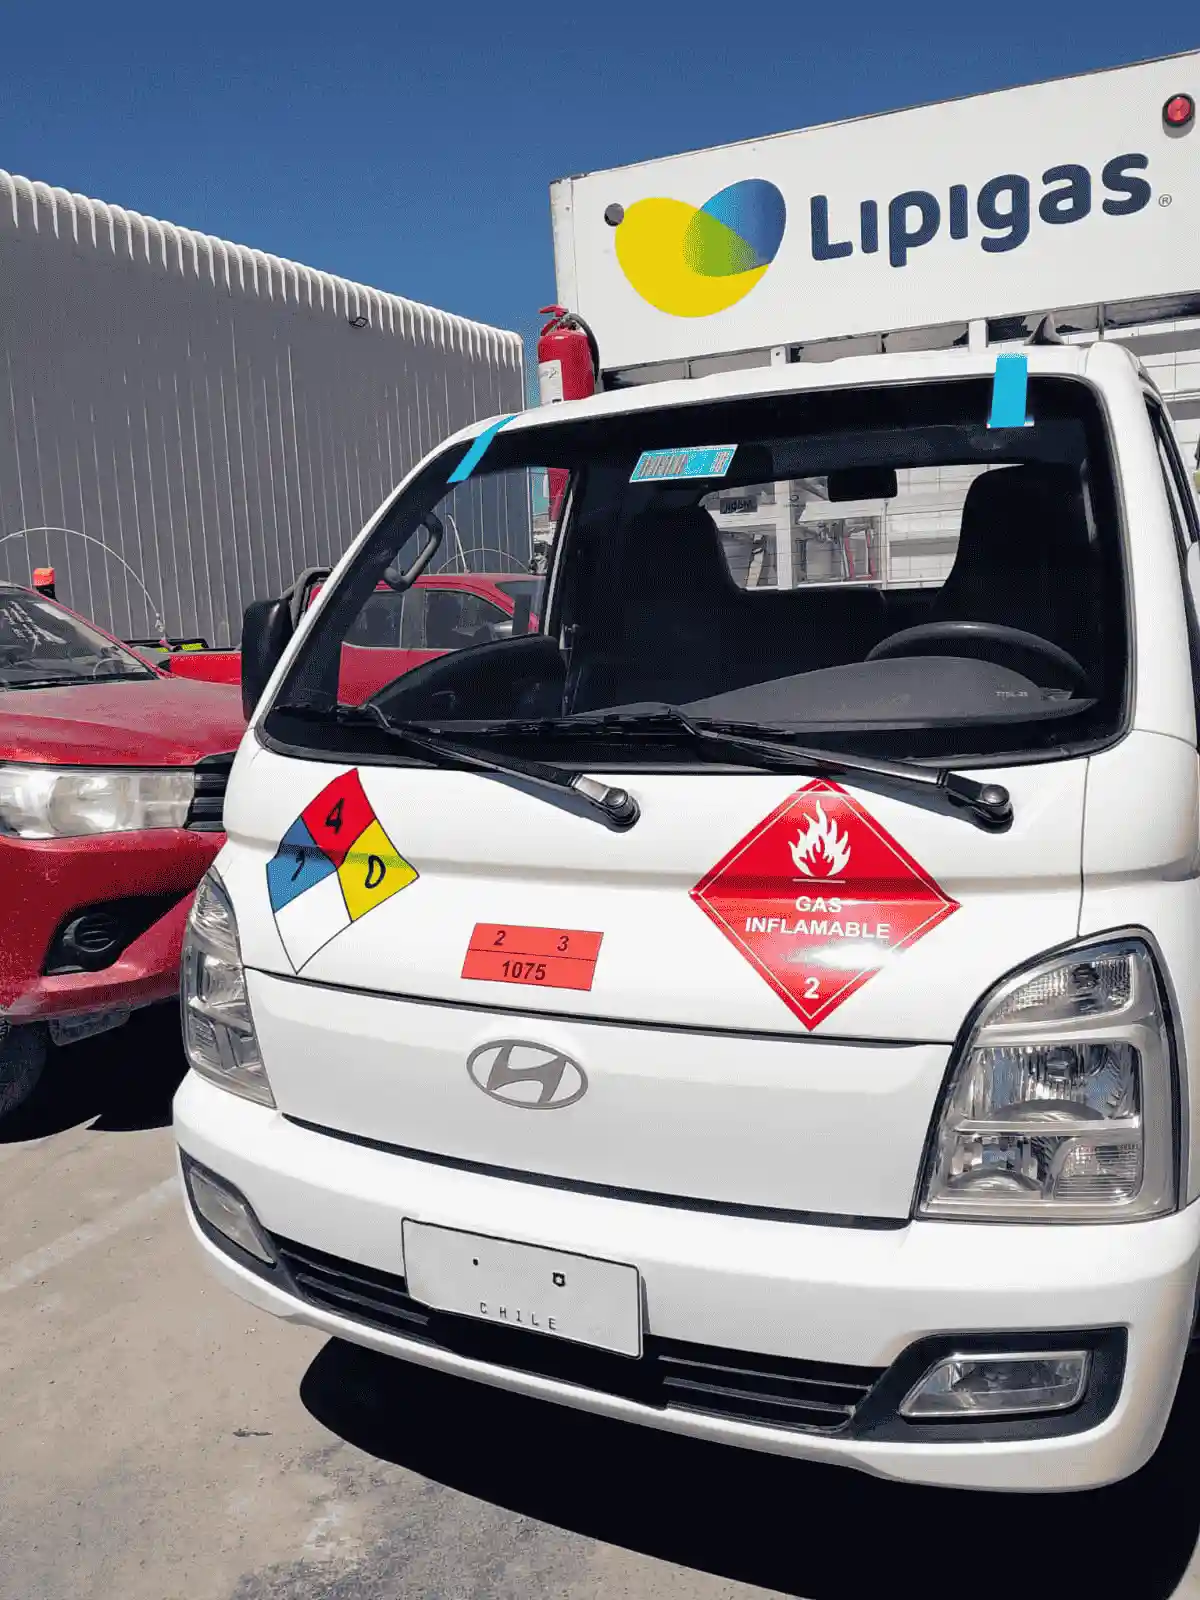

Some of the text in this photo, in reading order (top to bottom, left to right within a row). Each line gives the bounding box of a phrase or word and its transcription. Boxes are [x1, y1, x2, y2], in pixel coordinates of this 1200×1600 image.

[810, 152, 1152, 268] Lipigas
[324, 797, 345, 835] 4
[795, 895, 842, 913] GAS
[745, 916, 890, 939] INFLAMABLE
[493, 929, 570, 952] 2 3
[502, 959, 547, 981] 1075
[803, 976, 821, 999] 2
[479, 1301, 557, 1330] CHILE
